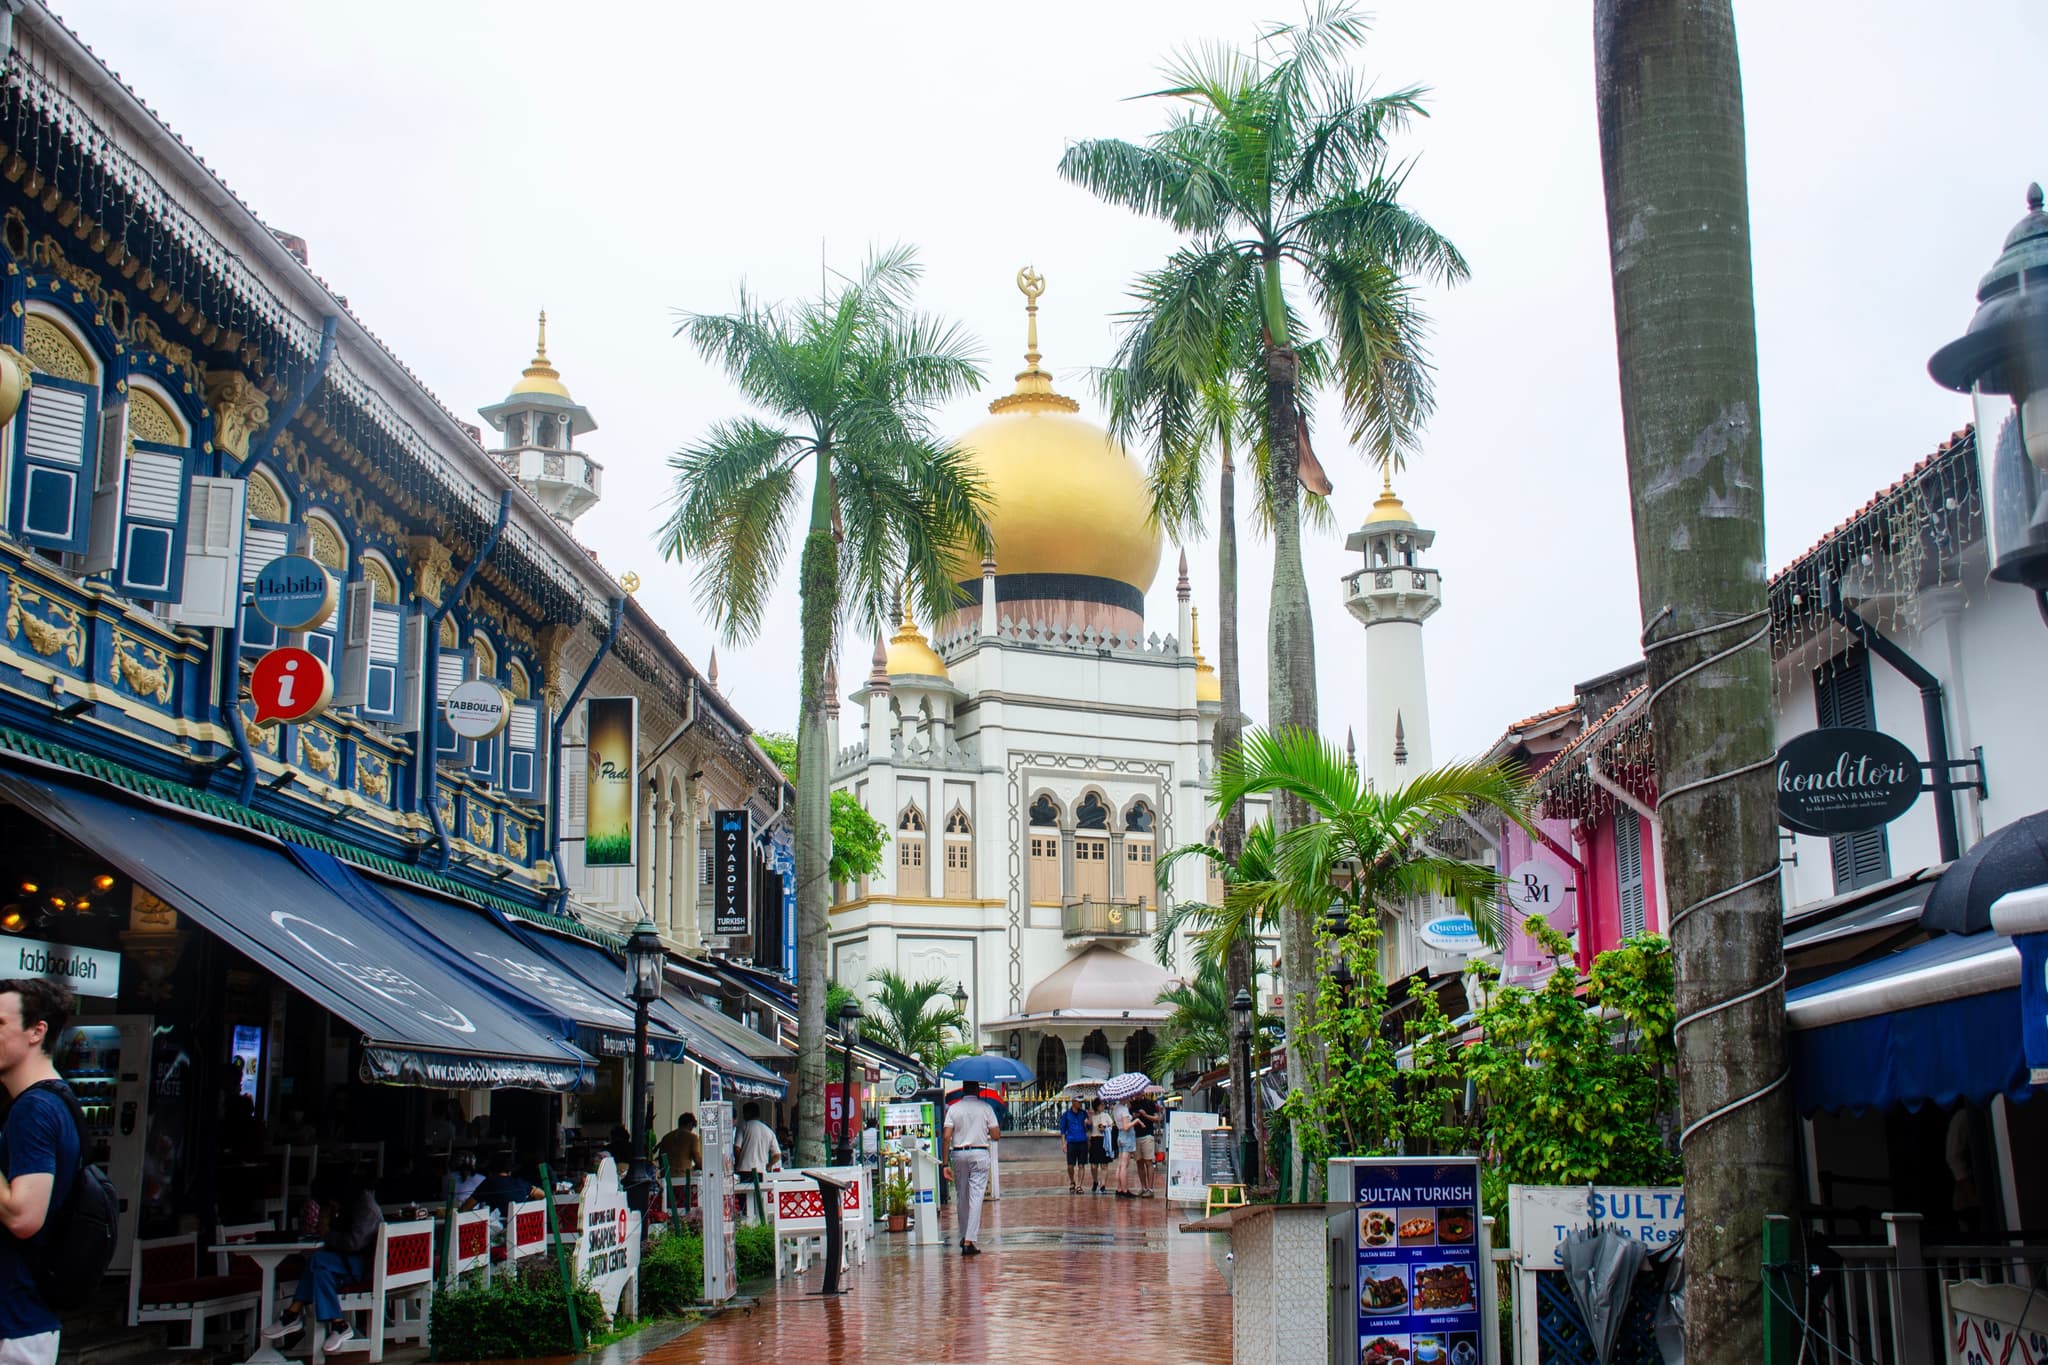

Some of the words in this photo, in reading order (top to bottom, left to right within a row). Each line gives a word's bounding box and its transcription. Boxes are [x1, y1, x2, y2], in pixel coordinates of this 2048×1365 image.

[259, 576, 323, 594] Habibi
[448, 700, 502, 713] TABBOULEH
[1778, 752, 1910, 793] konditori
[1808, 792, 1849, 804] ARTISAN
[1851, 790, 1884, 800] BAKES
[727, 832, 737, 915] AYASOFYA
[717, 917, 746, 926] TURKISH
[19, 946, 97, 980] tabbouleh
[1360, 1187, 1411, 1202] SULTAN
[1414, 1186, 1472, 1201] TURKISH
[589, 1225, 617, 1253] SINGAPORE
[608, 1247, 627, 1273] CENTRE
